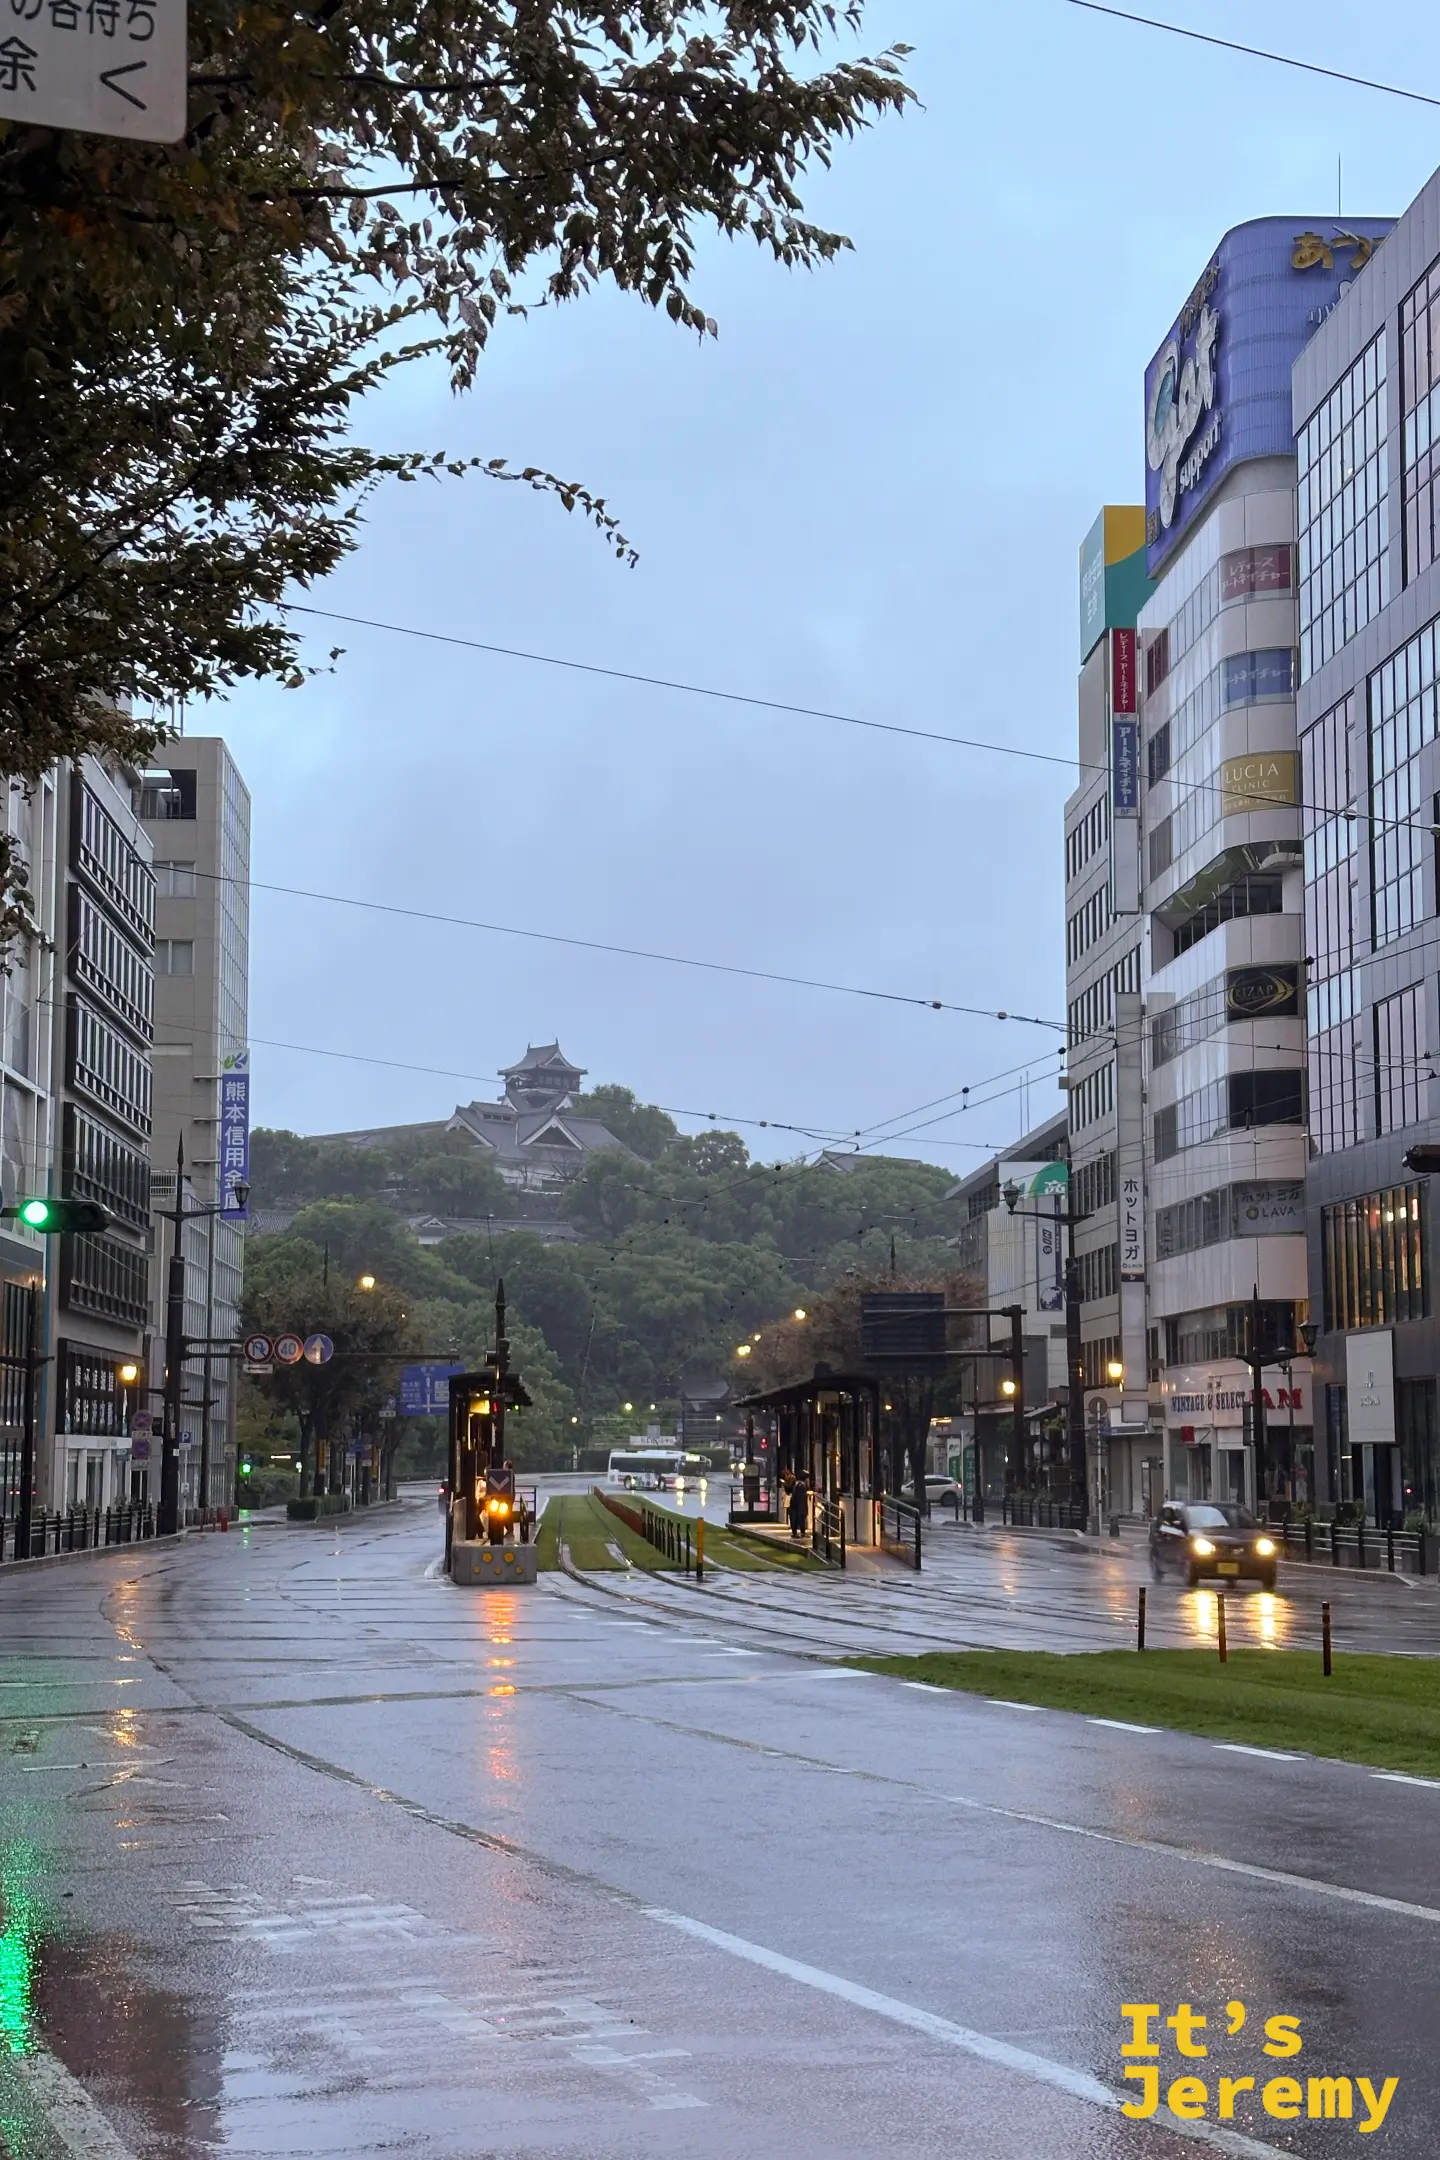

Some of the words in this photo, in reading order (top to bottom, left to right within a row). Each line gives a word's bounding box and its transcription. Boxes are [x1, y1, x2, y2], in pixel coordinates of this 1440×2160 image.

[1179, 408, 1223, 495] support
[1226, 763, 1279, 784] LUCIA
[1232, 779, 1269, 793] CLINIC
[1235, 984, 1273, 998] RIZAP
[224, 1081, 246, 1210] 熊本信用金庫
[1123, 1178, 1140, 1260] ホットヨガ
[1262, 1206, 1297, 1218] LAVA
[281, 1342, 297, 1356] 40
[1171, 1394, 1205, 1413] VINTAGE
[1216, 1391, 1246, 1410] SELECT
